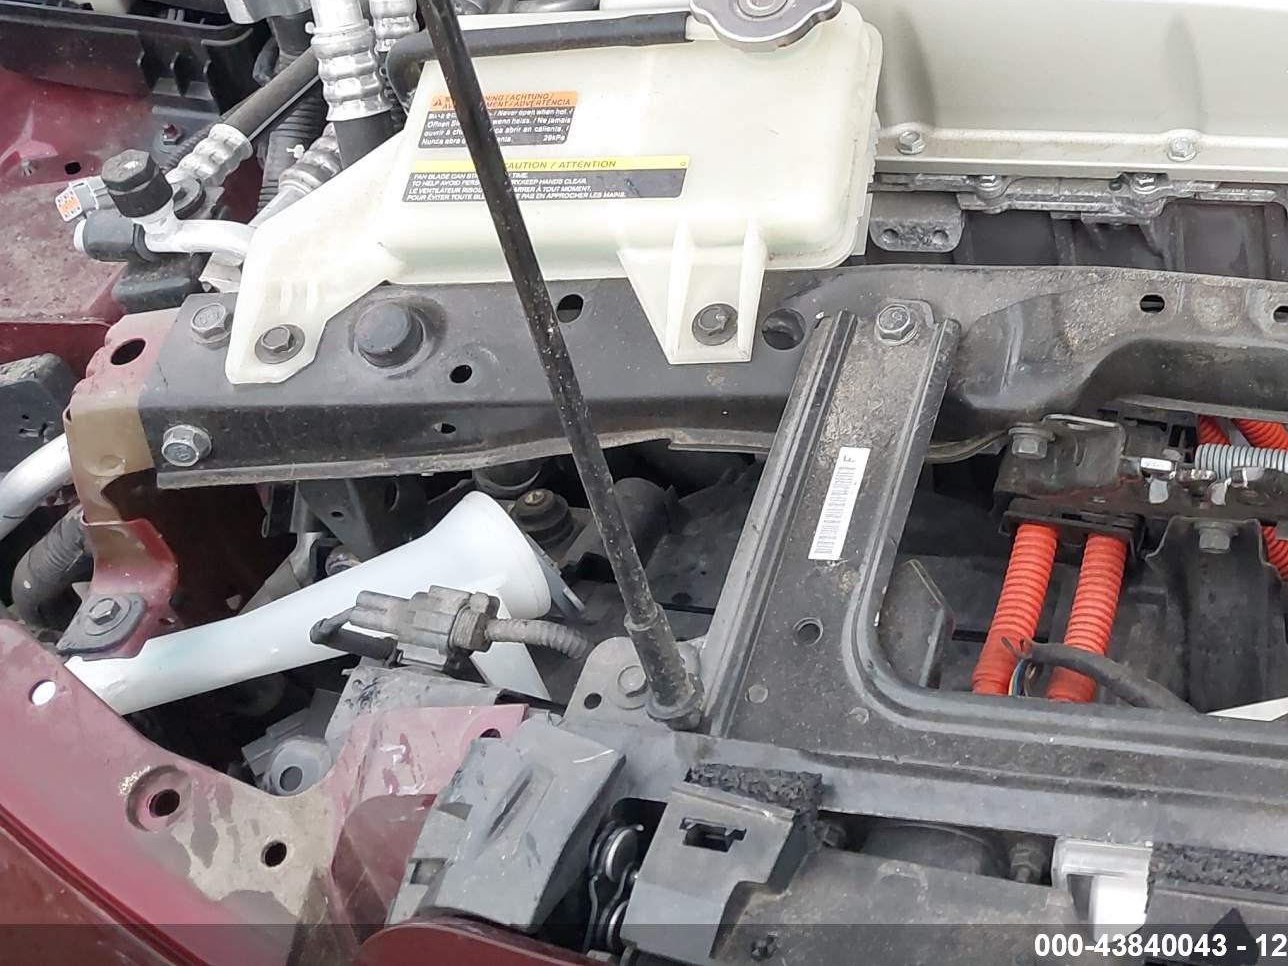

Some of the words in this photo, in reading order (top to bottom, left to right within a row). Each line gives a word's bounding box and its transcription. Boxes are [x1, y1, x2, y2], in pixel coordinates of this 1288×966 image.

[510, 93, 549, 101] ACHTUNG
[518, 109, 535, 117] open
[559, 160, 617, 168] ATTENTION
